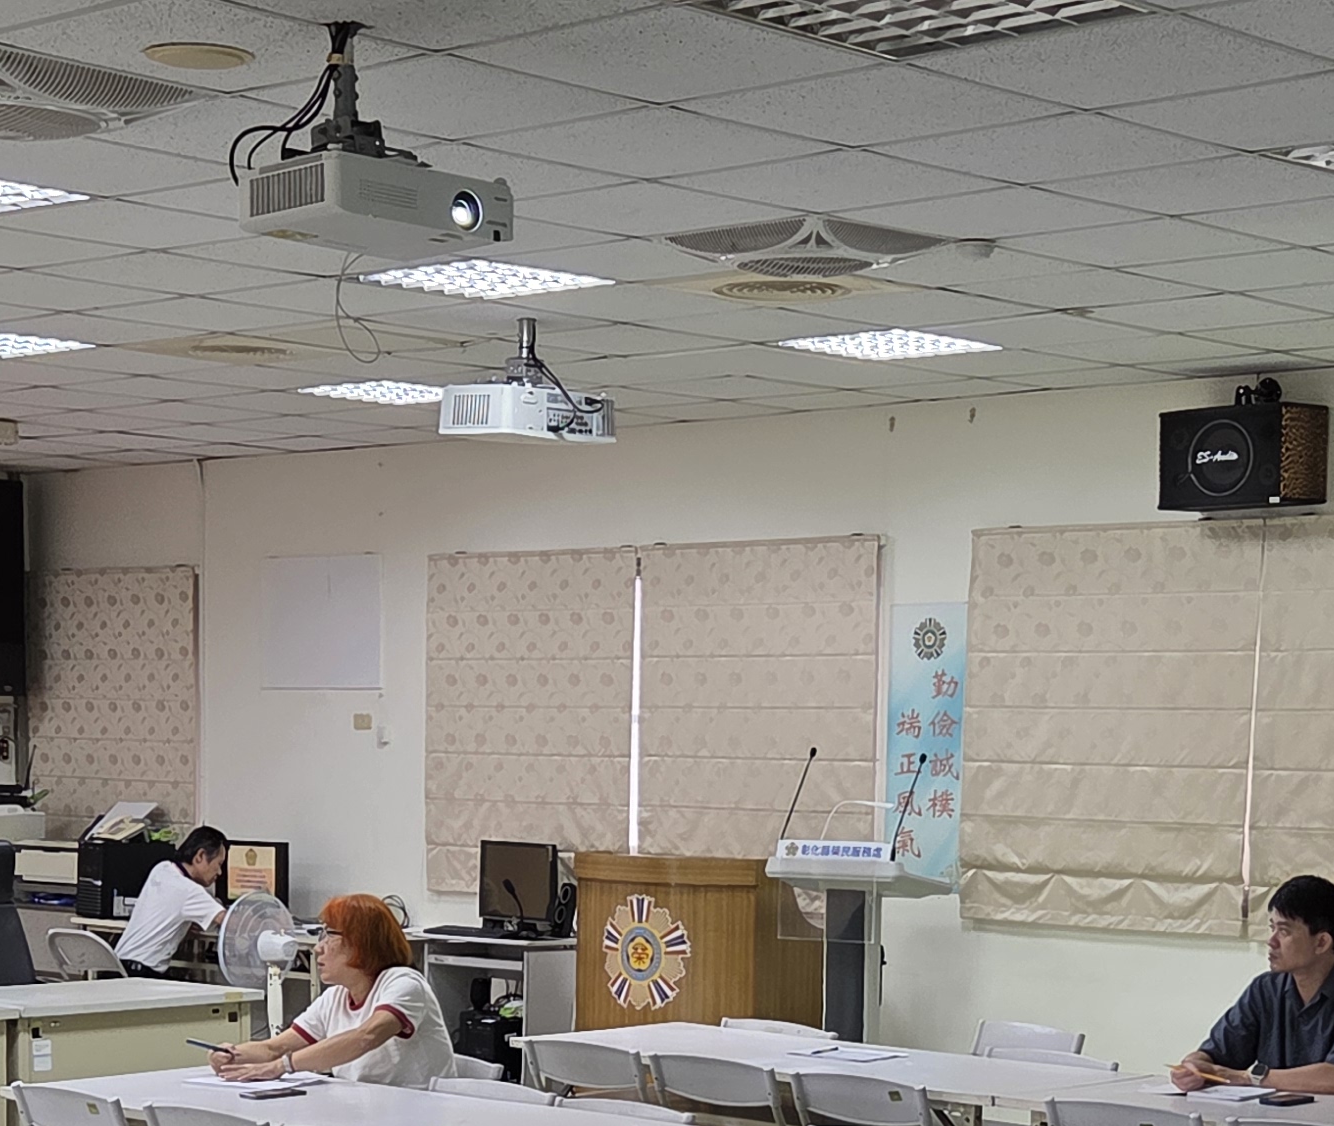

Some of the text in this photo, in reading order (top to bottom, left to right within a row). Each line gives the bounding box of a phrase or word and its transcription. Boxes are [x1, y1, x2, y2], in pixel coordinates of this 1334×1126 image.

[893, 708, 922, 858] 端正風氣
[926, 669, 960, 819] 勤儉誠樸
